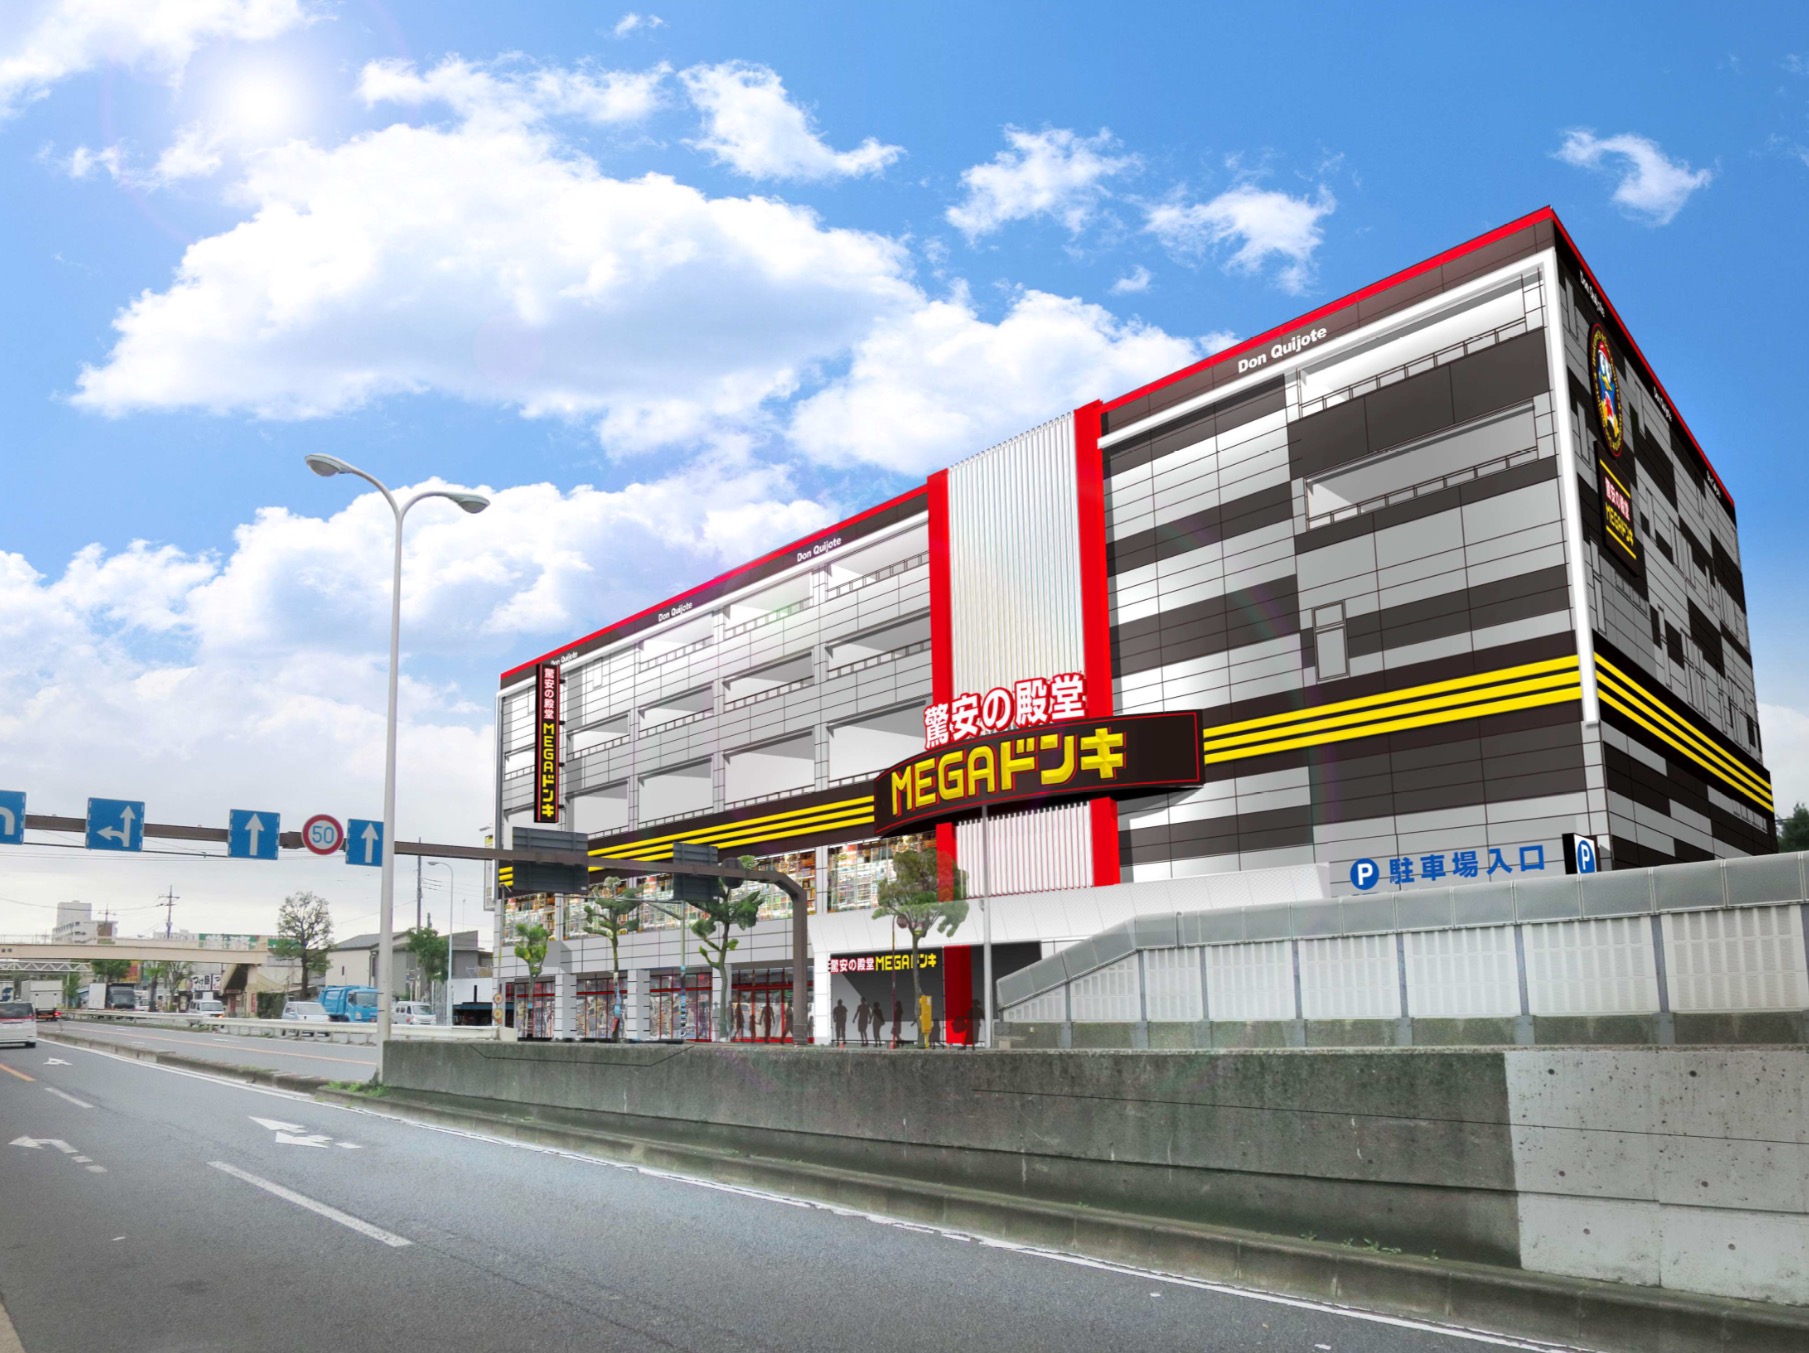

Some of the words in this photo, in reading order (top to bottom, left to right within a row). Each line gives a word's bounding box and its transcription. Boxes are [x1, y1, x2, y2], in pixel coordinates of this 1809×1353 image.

[1238, 352, 1267, 373] Don
[1271, 328, 1327, 358] Quijote
[797, 550, 812, 562] Don
[813, 537, 842, 555] Quijote
[658, 612, 670, 622] Don
[924, 672, 1086, 750] 驚安の殿堂
[542, 722, 555, 818] MEGAドンキ
[891, 727, 1124, 816] MEGAドンキ
[311, 825, 335, 844] 50
[1389, 844, 1545, 885] 駐車場入口
